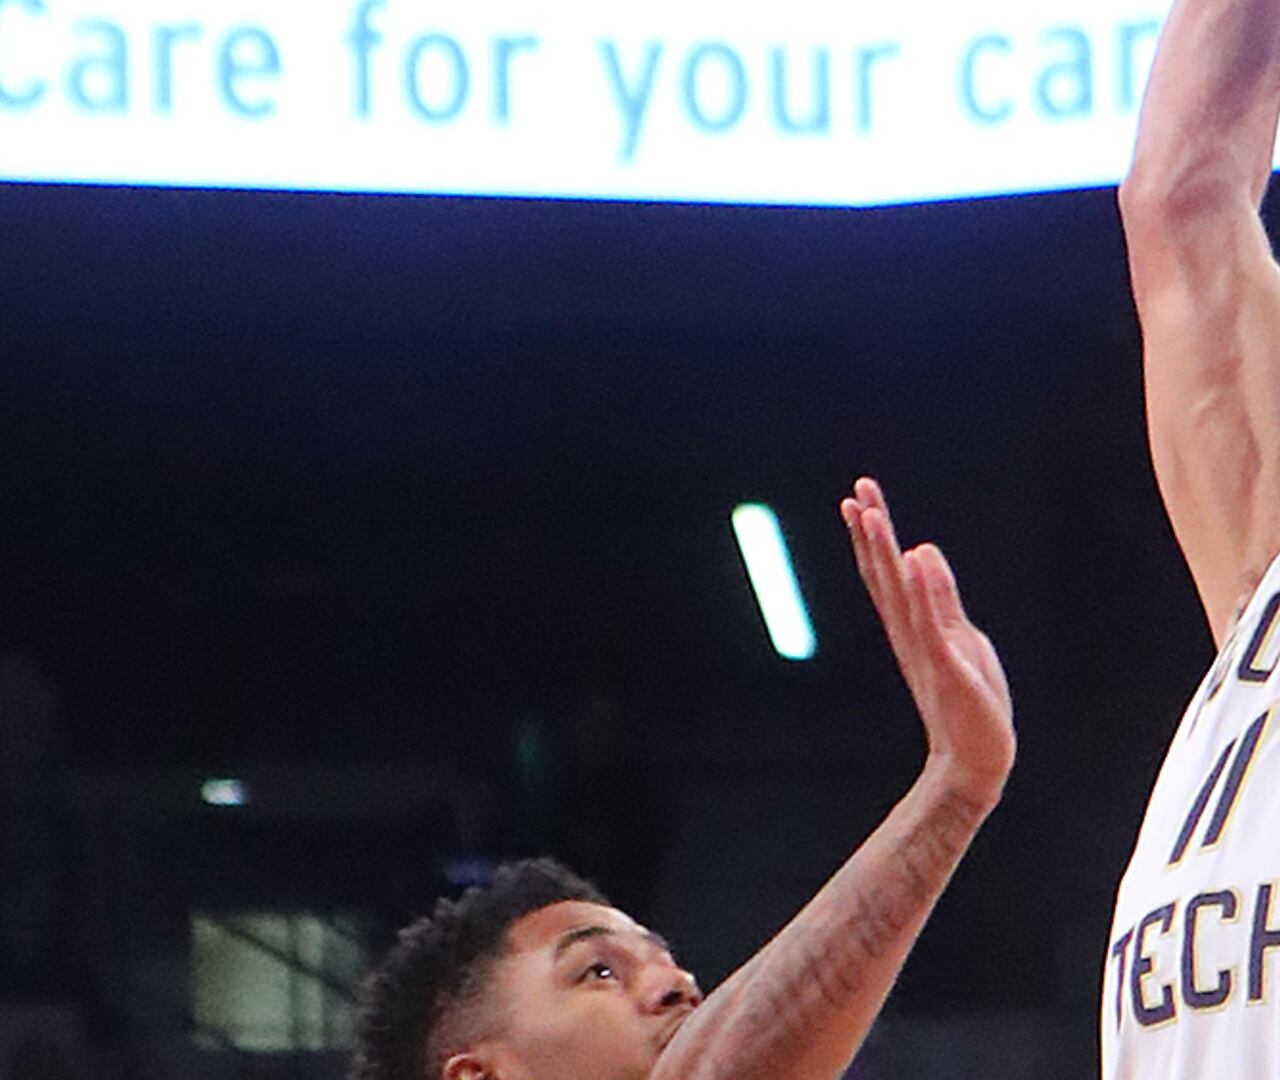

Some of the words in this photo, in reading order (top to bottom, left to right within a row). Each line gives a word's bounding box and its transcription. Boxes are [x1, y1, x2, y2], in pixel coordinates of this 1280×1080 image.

[343, 0, 539, 125] for
[597, 39, 899, 164] your
[1164, 706, 1276, 870] 11
